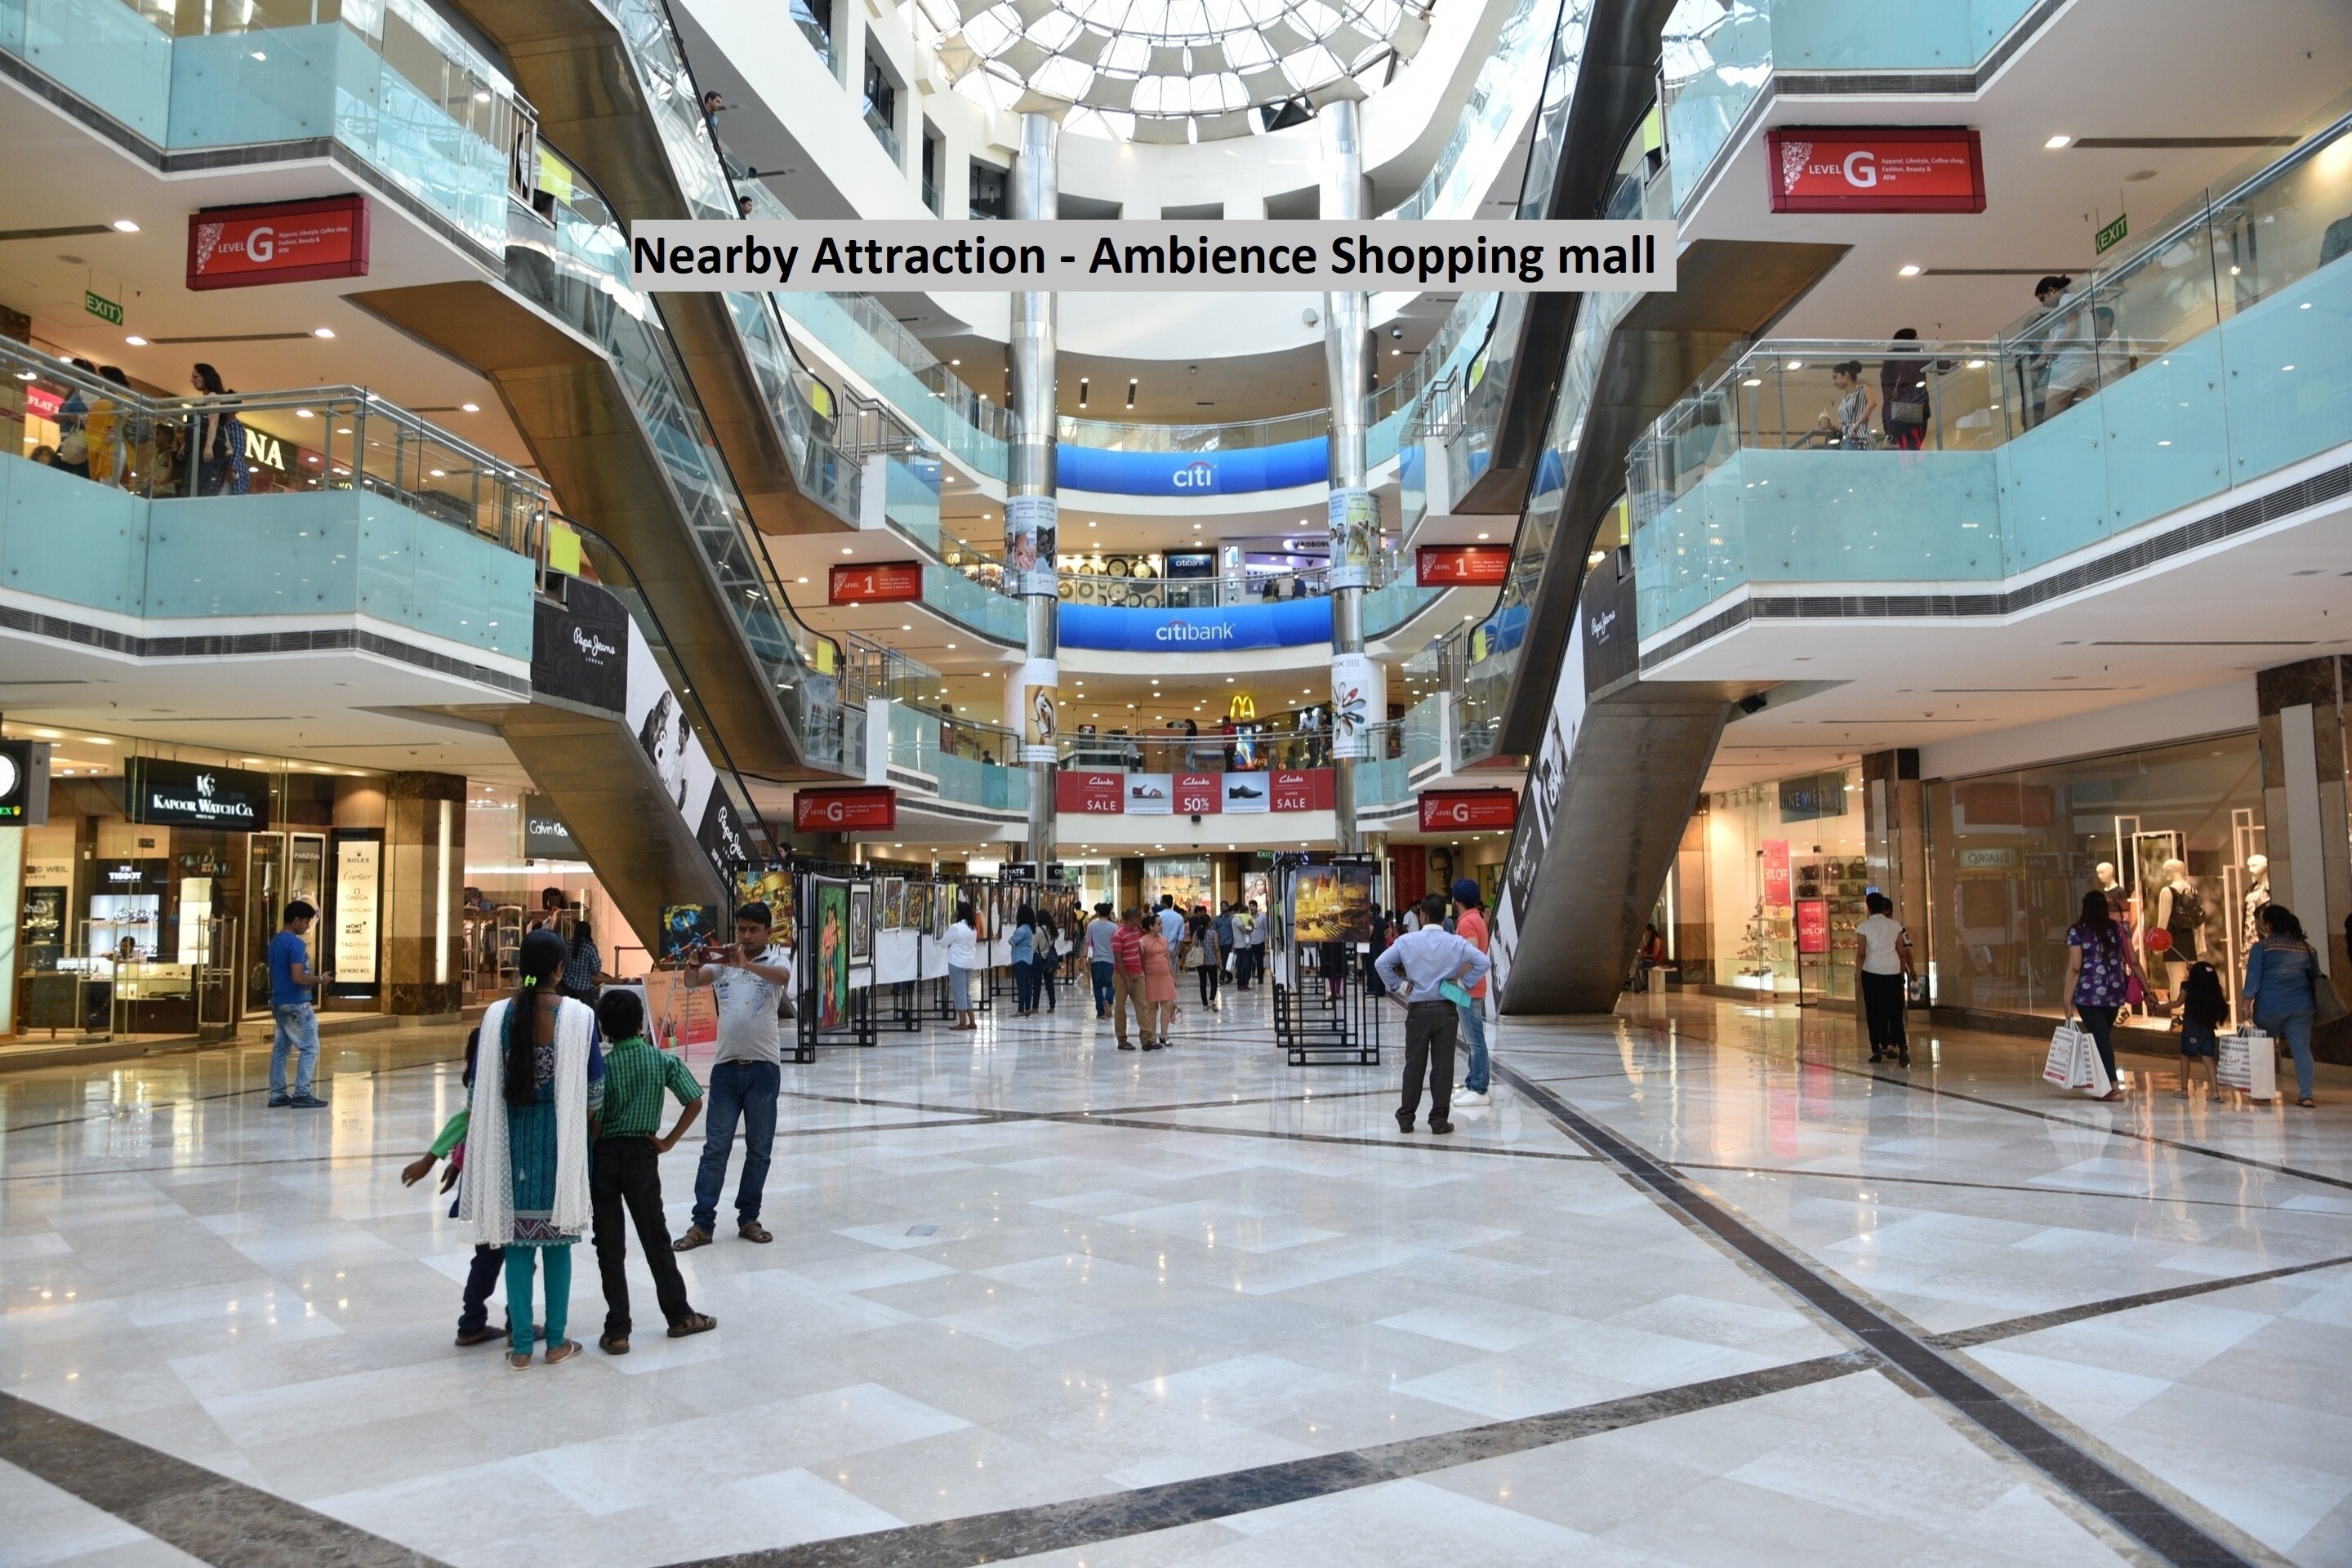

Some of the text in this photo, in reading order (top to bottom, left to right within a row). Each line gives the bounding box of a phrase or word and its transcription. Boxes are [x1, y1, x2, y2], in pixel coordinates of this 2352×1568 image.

[1809, 151, 1877, 188] LEVEL G
[320, 226, 336, 234] Coffee
[2100, 218, 2126, 248] EXIT
[218, 227, 274, 262] LEVEL G
[87, 295, 117, 319] EXIT
[28, 395, 53, 412] FLAT
[245, 429, 285, 470] NA
[1173, 462, 1211, 488] citi
[1176, 559, 1204, 568] citibank
[1455, 558, 1468, 576] 1
[864, 576, 875, 594] 1
[1156, 621, 1234, 641] citibank
[573, 626, 616, 657] Pepe Jeans
[1089, 777, 1115, 785] Clarks
[1183, 777, 1209, 786] Clarks
[1279, 775, 1303, 784] Clarks
[154, 794, 196, 812] KAPOOR
[198, 798, 234, 815] WATCH
[826, 801, 843, 822] G
[1087, 800, 1116, 811] SALE
[1183, 798, 1209, 812] 50%
[1277, 798, 1306, 808] SALE
[1452, 803, 1468, 822] G
[530, 821, 568, 836] Calvin Kle
[730, 833, 746, 861] Jea
[109, 872, 142, 880] TISSOT
[343, 871, 372, 880] Cartier
[1775, 869, 1788, 880] OFF
